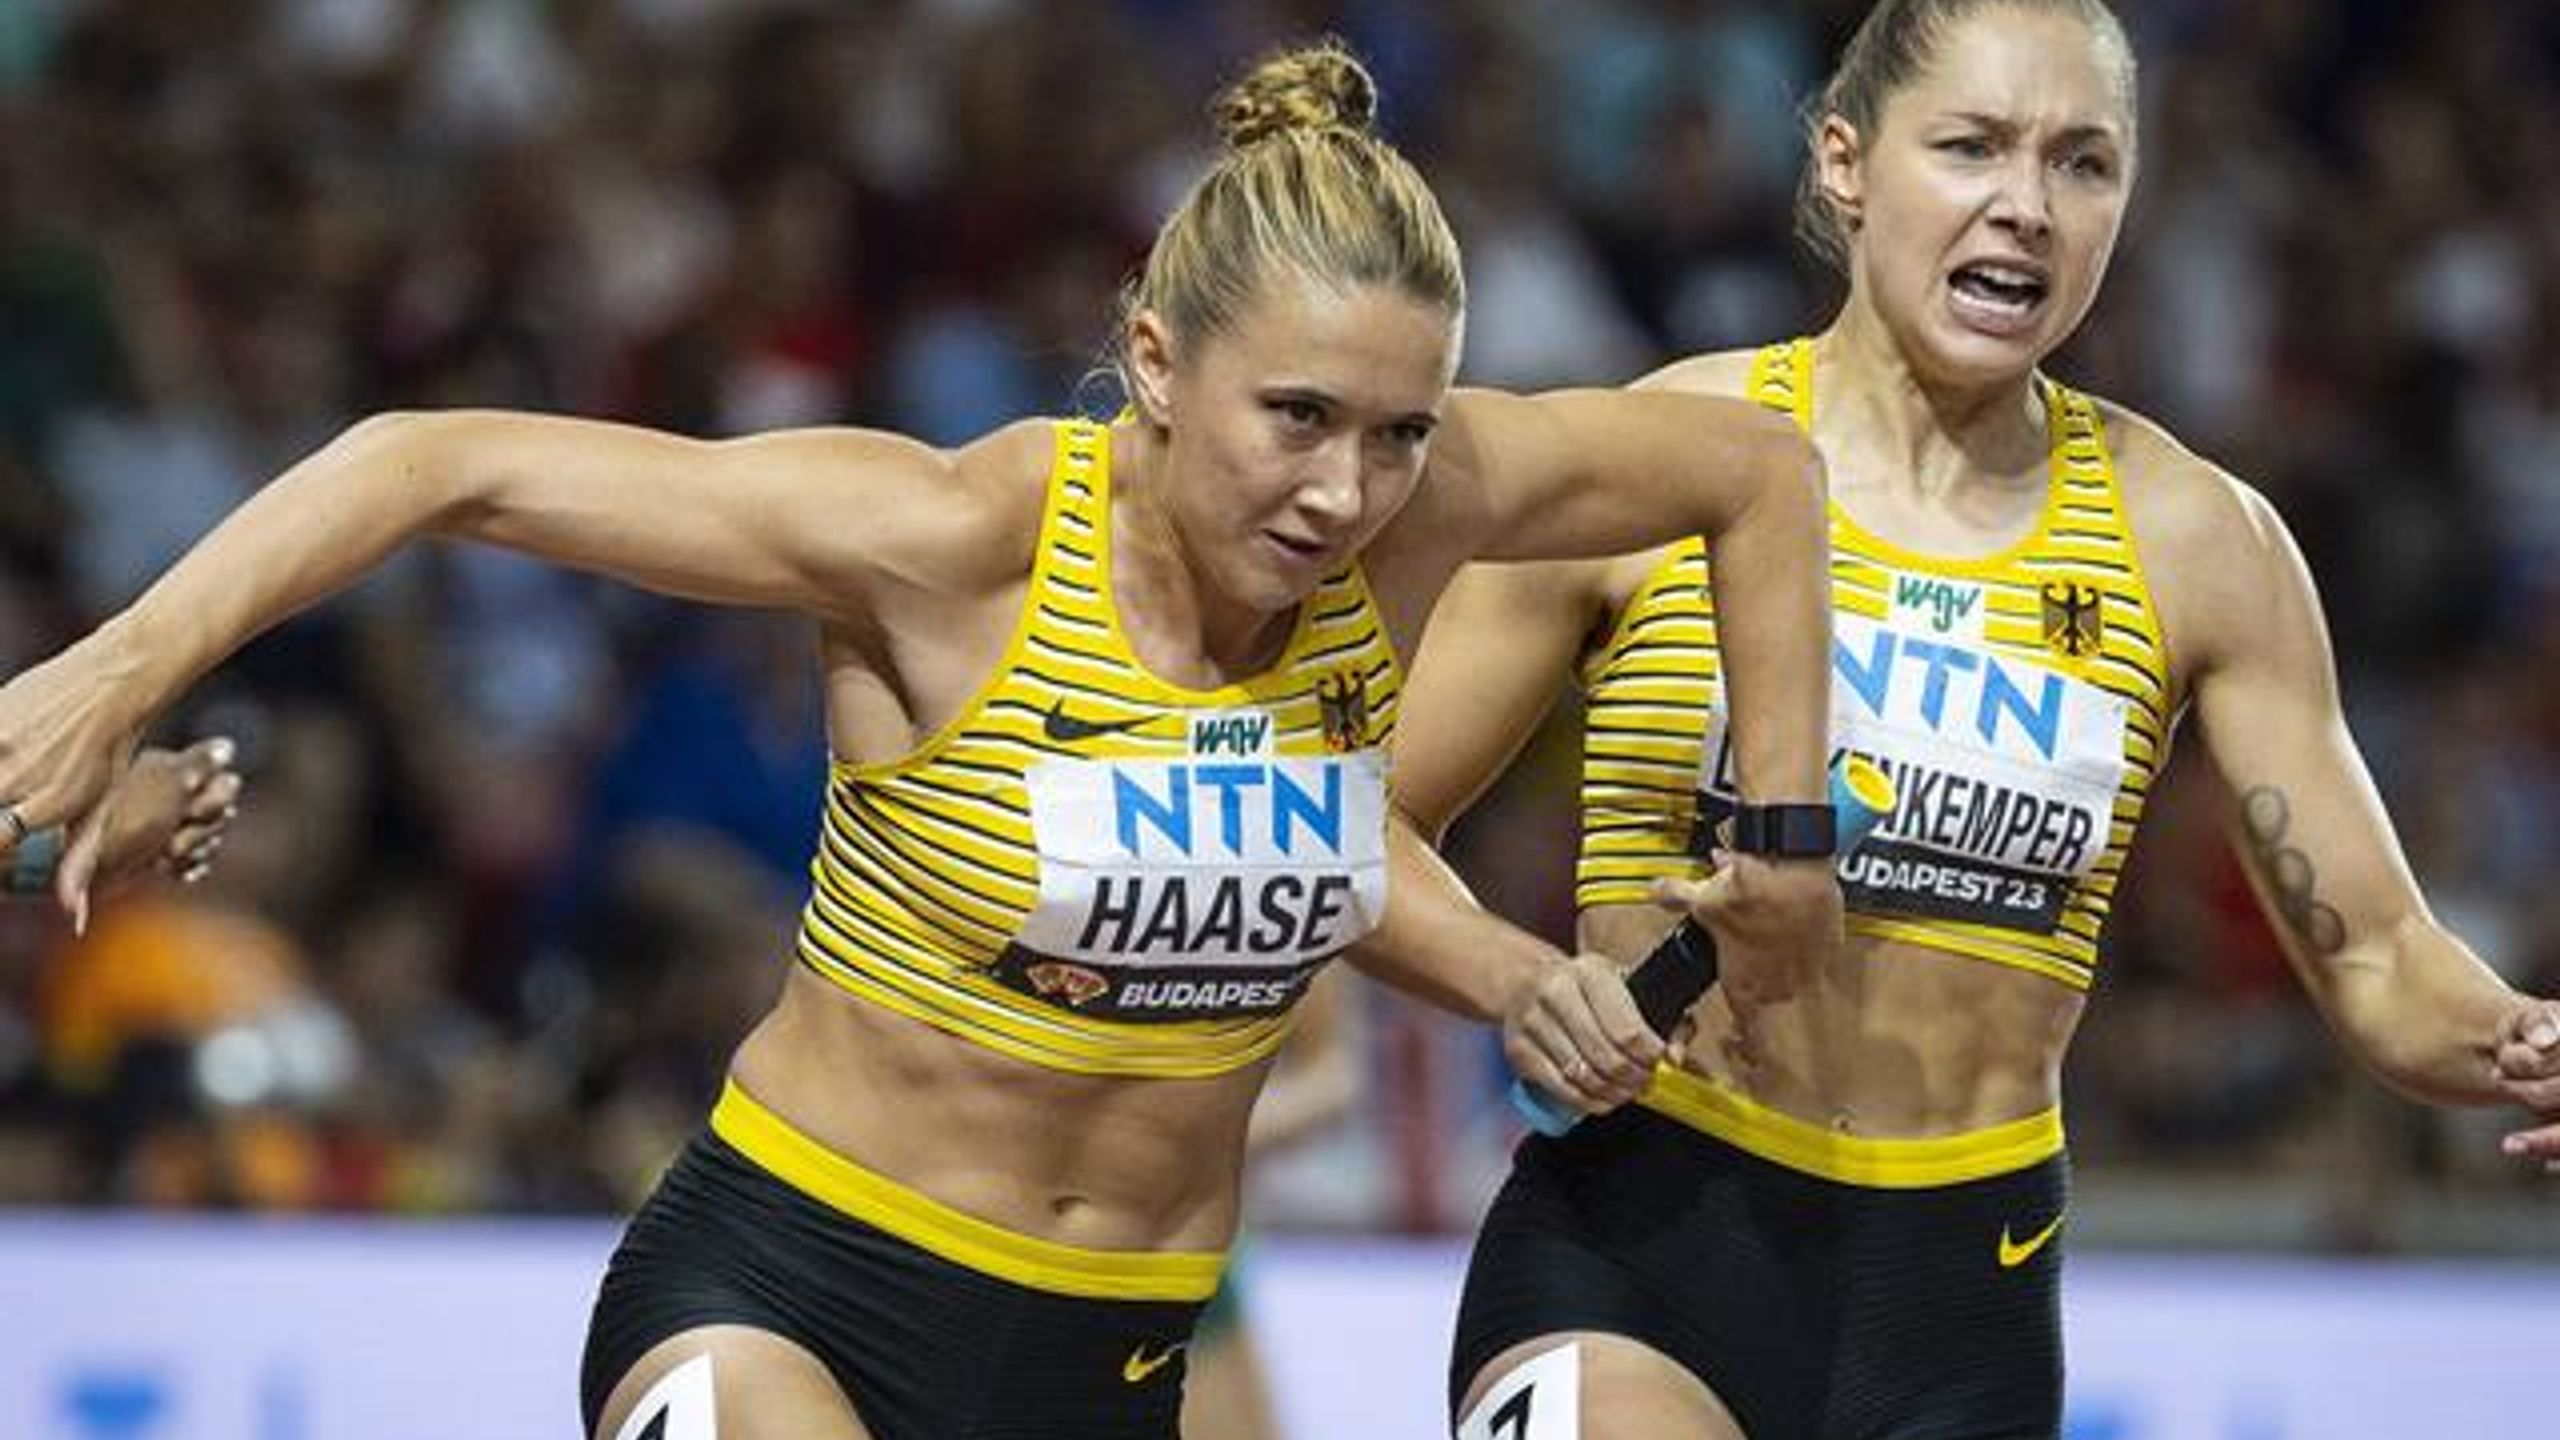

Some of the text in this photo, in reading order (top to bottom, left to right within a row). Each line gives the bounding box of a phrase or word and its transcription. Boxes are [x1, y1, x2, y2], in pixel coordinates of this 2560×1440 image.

[1832, 630, 2066, 763] NTN
[1111, 764, 1342, 858] NTN
[1076, 874, 1352, 954] HAASE
[1838, 852, 2046, 910] UDAPEST 23
[1116, 978, 1298, 1009] BUDAPES
